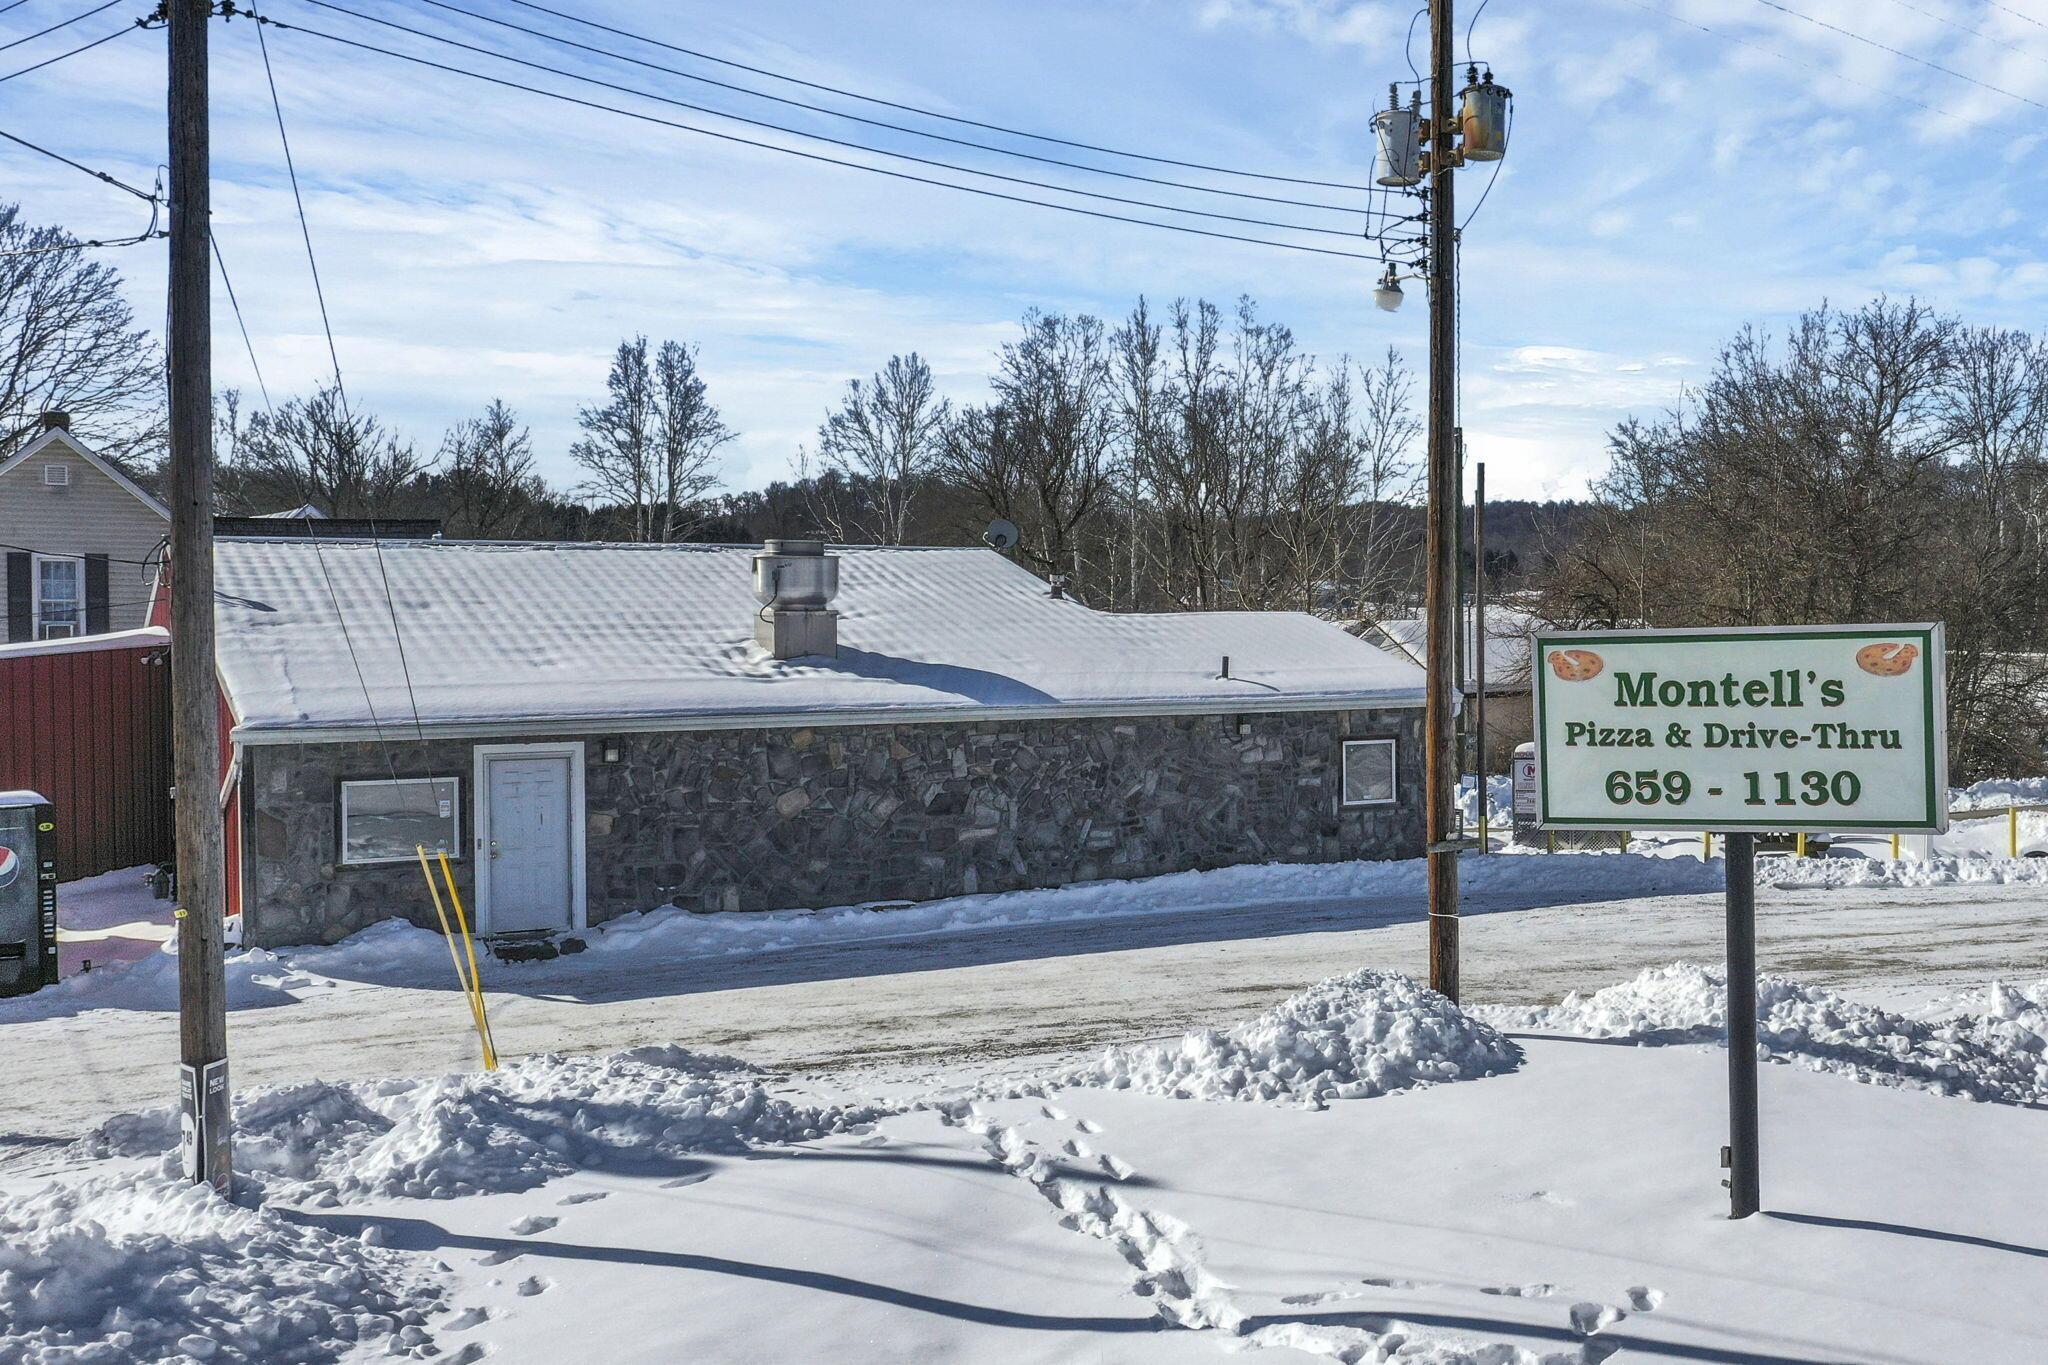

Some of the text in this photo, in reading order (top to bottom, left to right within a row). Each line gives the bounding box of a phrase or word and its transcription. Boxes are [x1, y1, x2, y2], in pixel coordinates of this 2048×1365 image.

[1613, 669, 1845, 708] Montell's
[1565, 720, 1903, 749] Pizza & Drive-Thru
[1605, 769, 1692, 806] 659
[1743, 770, 1862, 806] 1130
[209, 1074, 225, 1088] NEW
[209, 1083, 225, 1095] LOOK
